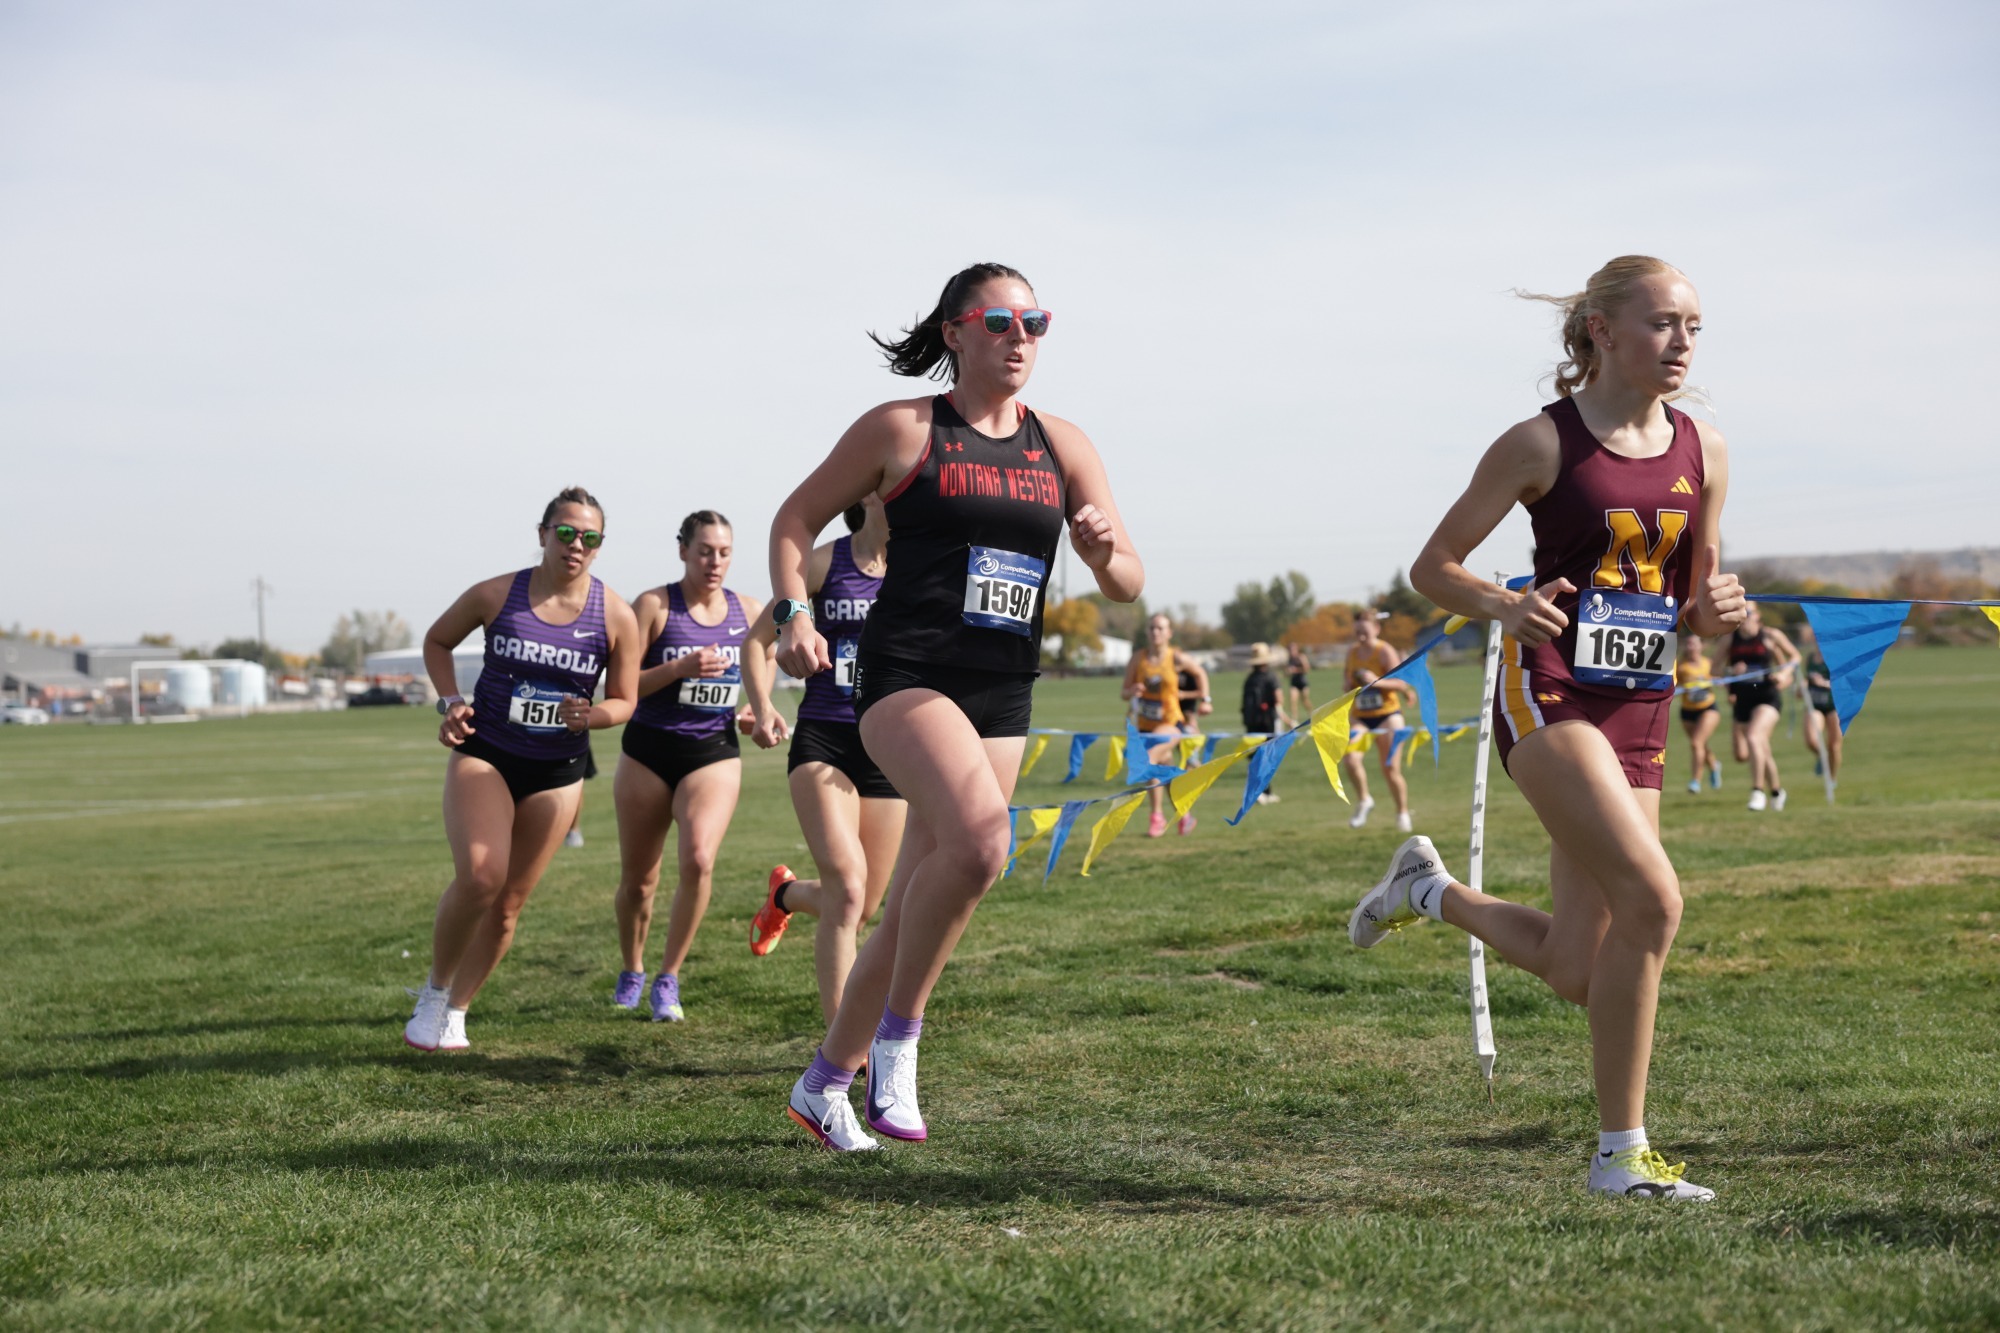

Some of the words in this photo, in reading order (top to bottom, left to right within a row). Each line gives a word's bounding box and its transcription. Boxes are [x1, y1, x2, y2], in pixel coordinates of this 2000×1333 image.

[939, 462, 1002, 497] MONTANA
[1004, 467, 1060, 509] WESTERN
[1590, 508, 1689, 596] N
[824, 599, 878, 621] CAR
[977, 580, 1032, 620] 1598
[493, 634, 599, 675] CARROLL
[1589, 627, 1666, 671] 1632
[690, 685, 732, 705] 1507
[1418, 860, 1434, 871] ON
